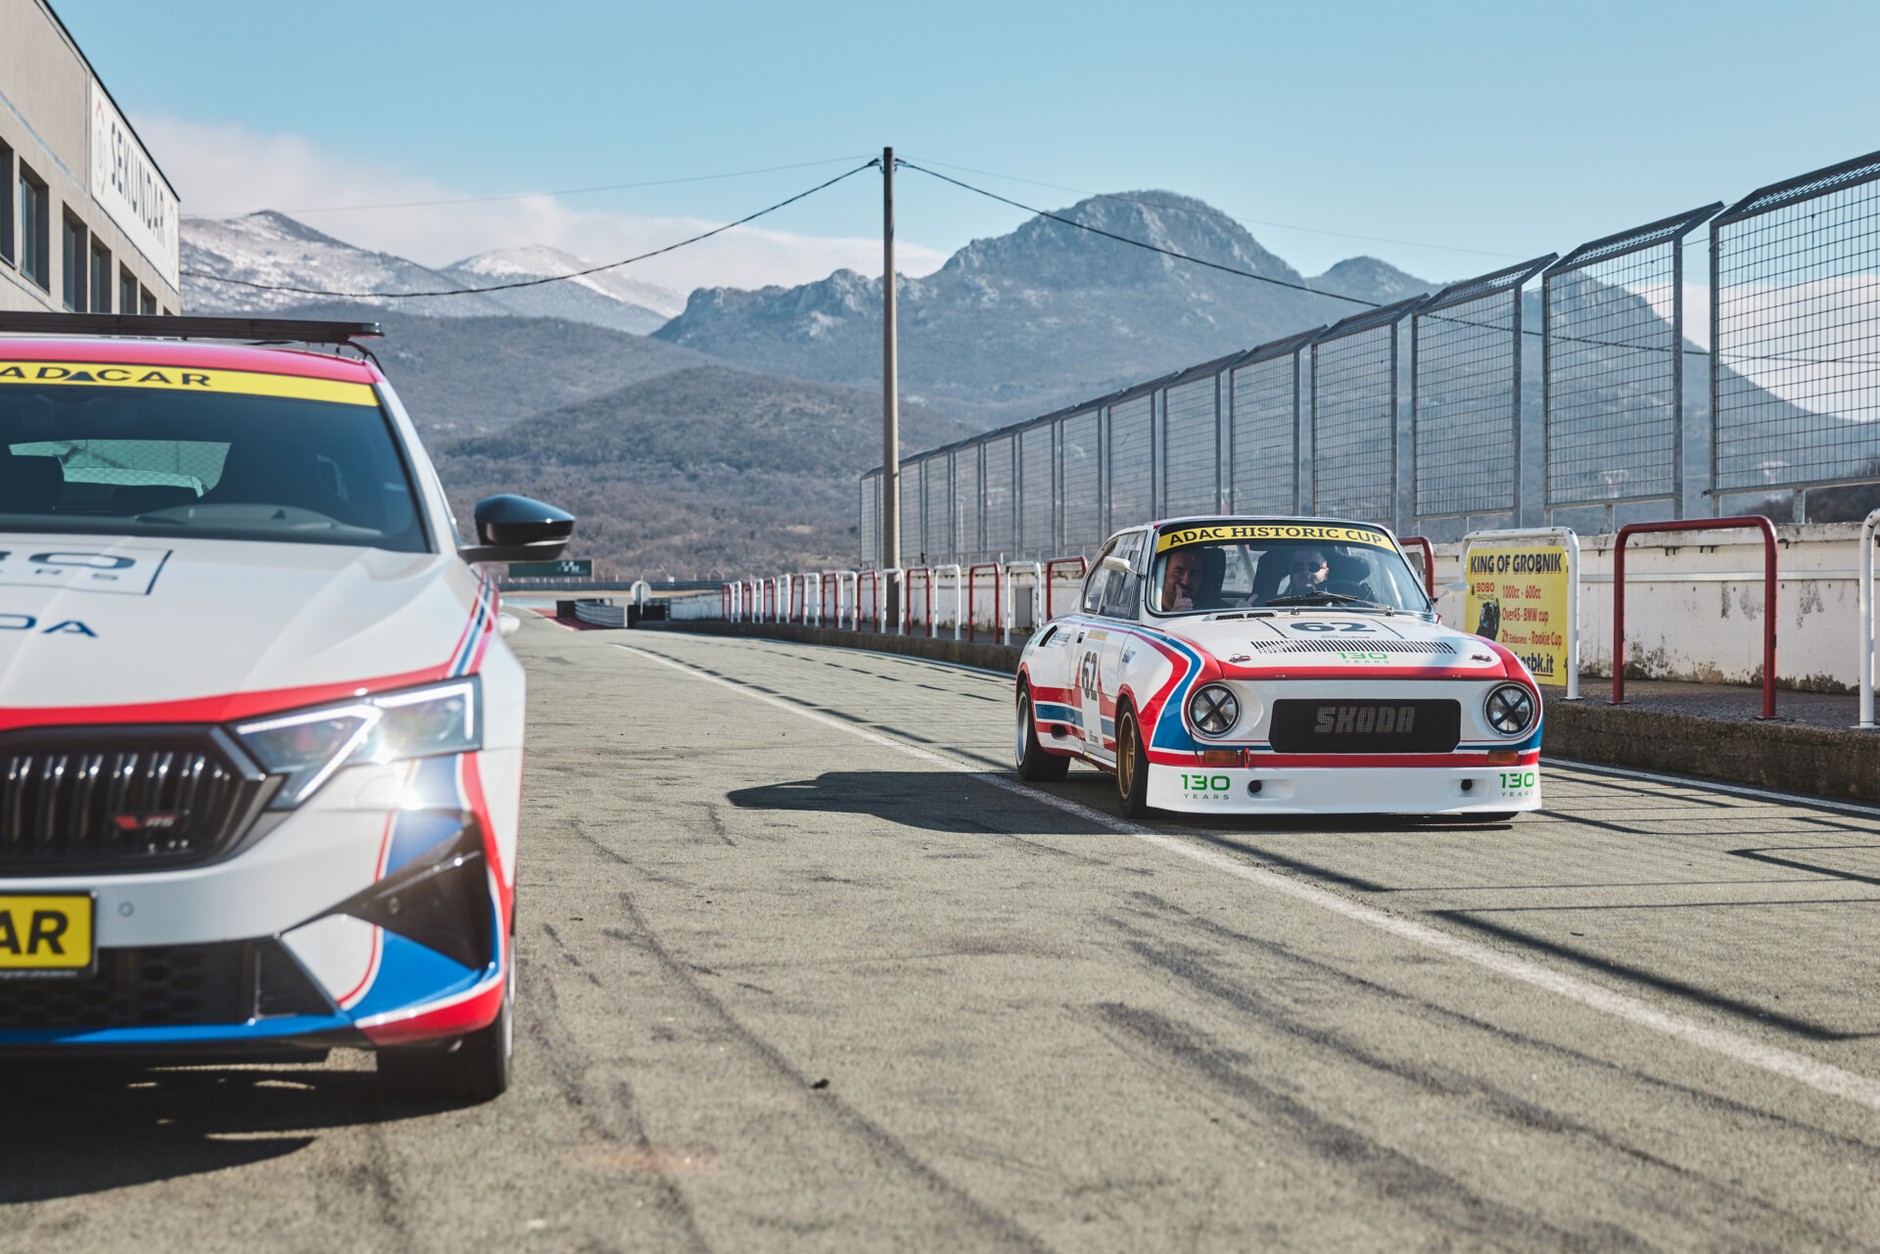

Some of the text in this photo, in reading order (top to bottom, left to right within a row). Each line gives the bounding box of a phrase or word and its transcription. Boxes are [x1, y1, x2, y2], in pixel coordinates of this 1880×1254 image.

[112, 121, 165, 248] SEKUNDAR
[97, 369, 211, 387] CAR
[1169, 526, 1383, 546] ADAC HISTORIC CUP
[1470, 553, 1562, 573] KING OF GROBNIK
[1476, 582, 1495, 593] BOBO
[1502, 585, 1520, 599] 1000cc
[1525, 585, 1541, 599] 600cc
[1502, 607, 1520, 621] Over45
[1523, 607, 1538, 621] BMW
[1539, 611, 1549, 627] cup
[1290, 622, 1376, 633] 62
[1502, 629, 1509, 643] 2h
[1531, 630, 1550, 645] Rookie
[1551, 632, 1562, 650] Cup
[1336, 652, 1389, 660] 130
[1515, 651, 1554, 673] osbk.it
[1082, 651, 1098, 701] 62
[1314, 706, 1416, 734] SKODA
[1180, 774, 1231, 791] 130
[1499, 772, 1535, 788] 130
[145, 817, 175, 828] RS
